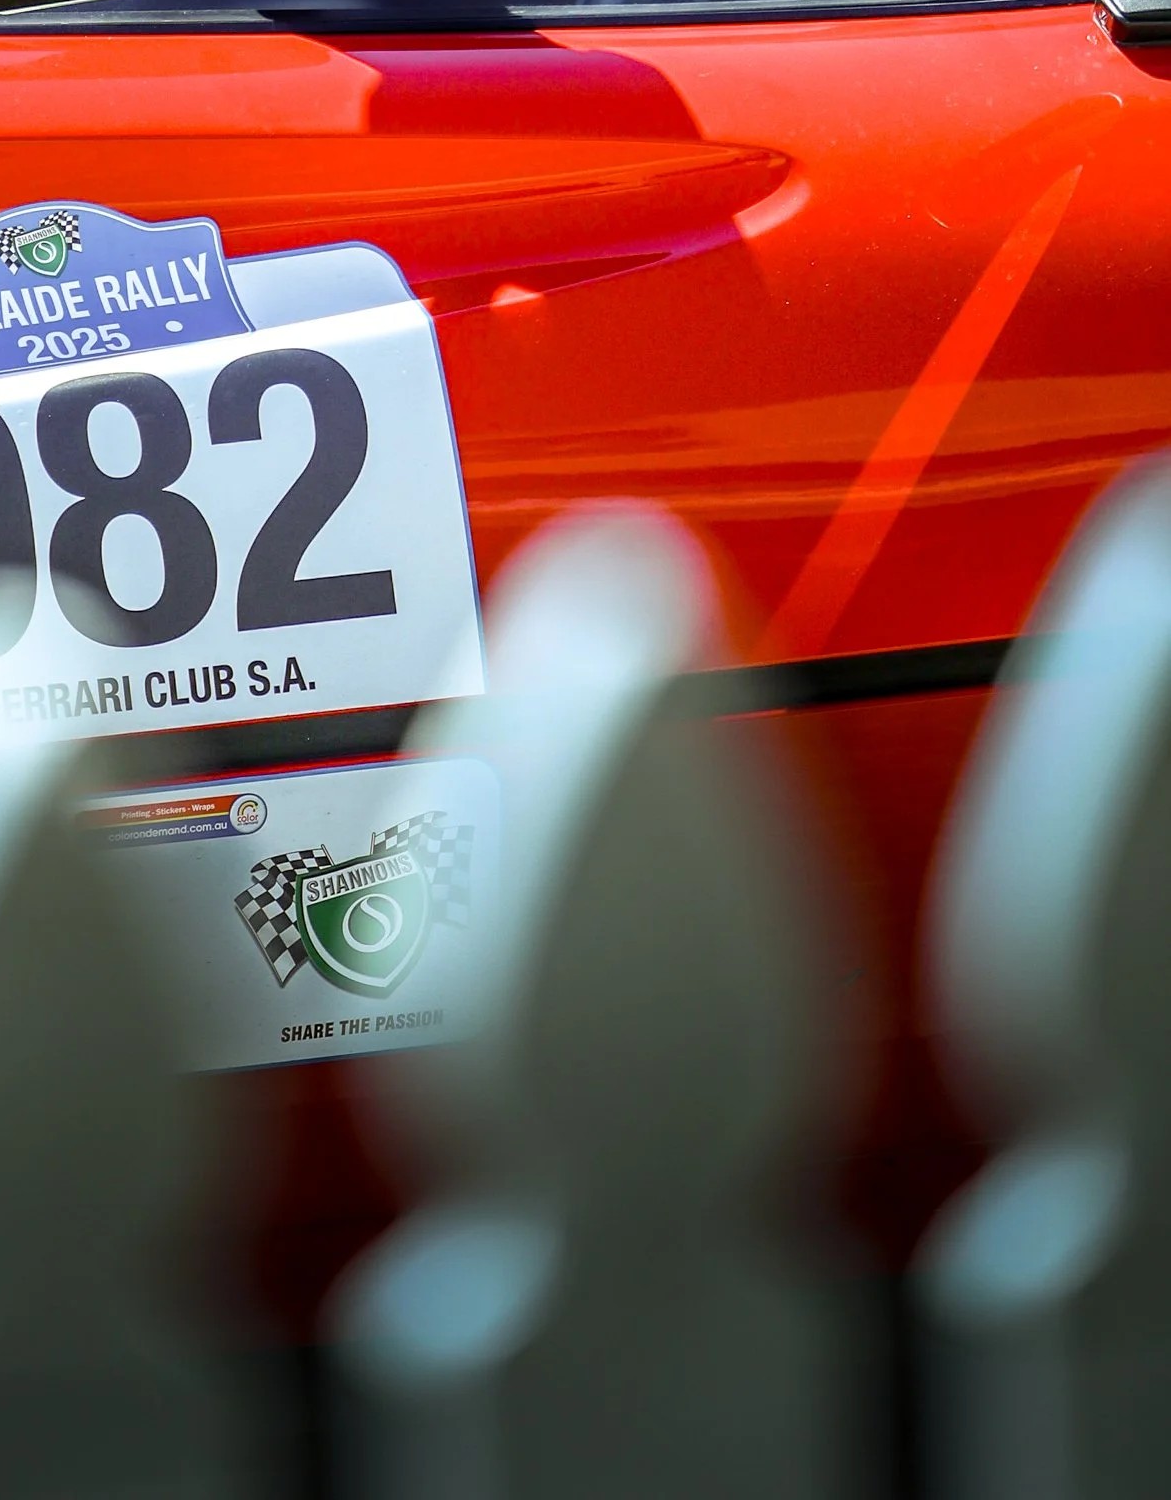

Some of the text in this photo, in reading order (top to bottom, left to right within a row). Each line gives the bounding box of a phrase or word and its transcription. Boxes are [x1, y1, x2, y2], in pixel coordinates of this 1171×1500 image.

[16, 226, 57, 246] SHANNONS
[94, 252, 212, 315] RALLY
[17, 323, 131, 364] 2025
[145, 664, 236, 710] CLUB
[249, 657, 316, 698] S.A.
[121, 810, 150, 819] Printing
[155, 807, 186, 816] Stickers
[192, 803, 215, 812] Wraps
[237, 814, 259, 822] color
[108, 821, 228, 842] colorondemand.com.au
[306, 854, 413, 902] SHANNONS
[281, 1009, 444, 1043] SHARE THE PASSION
